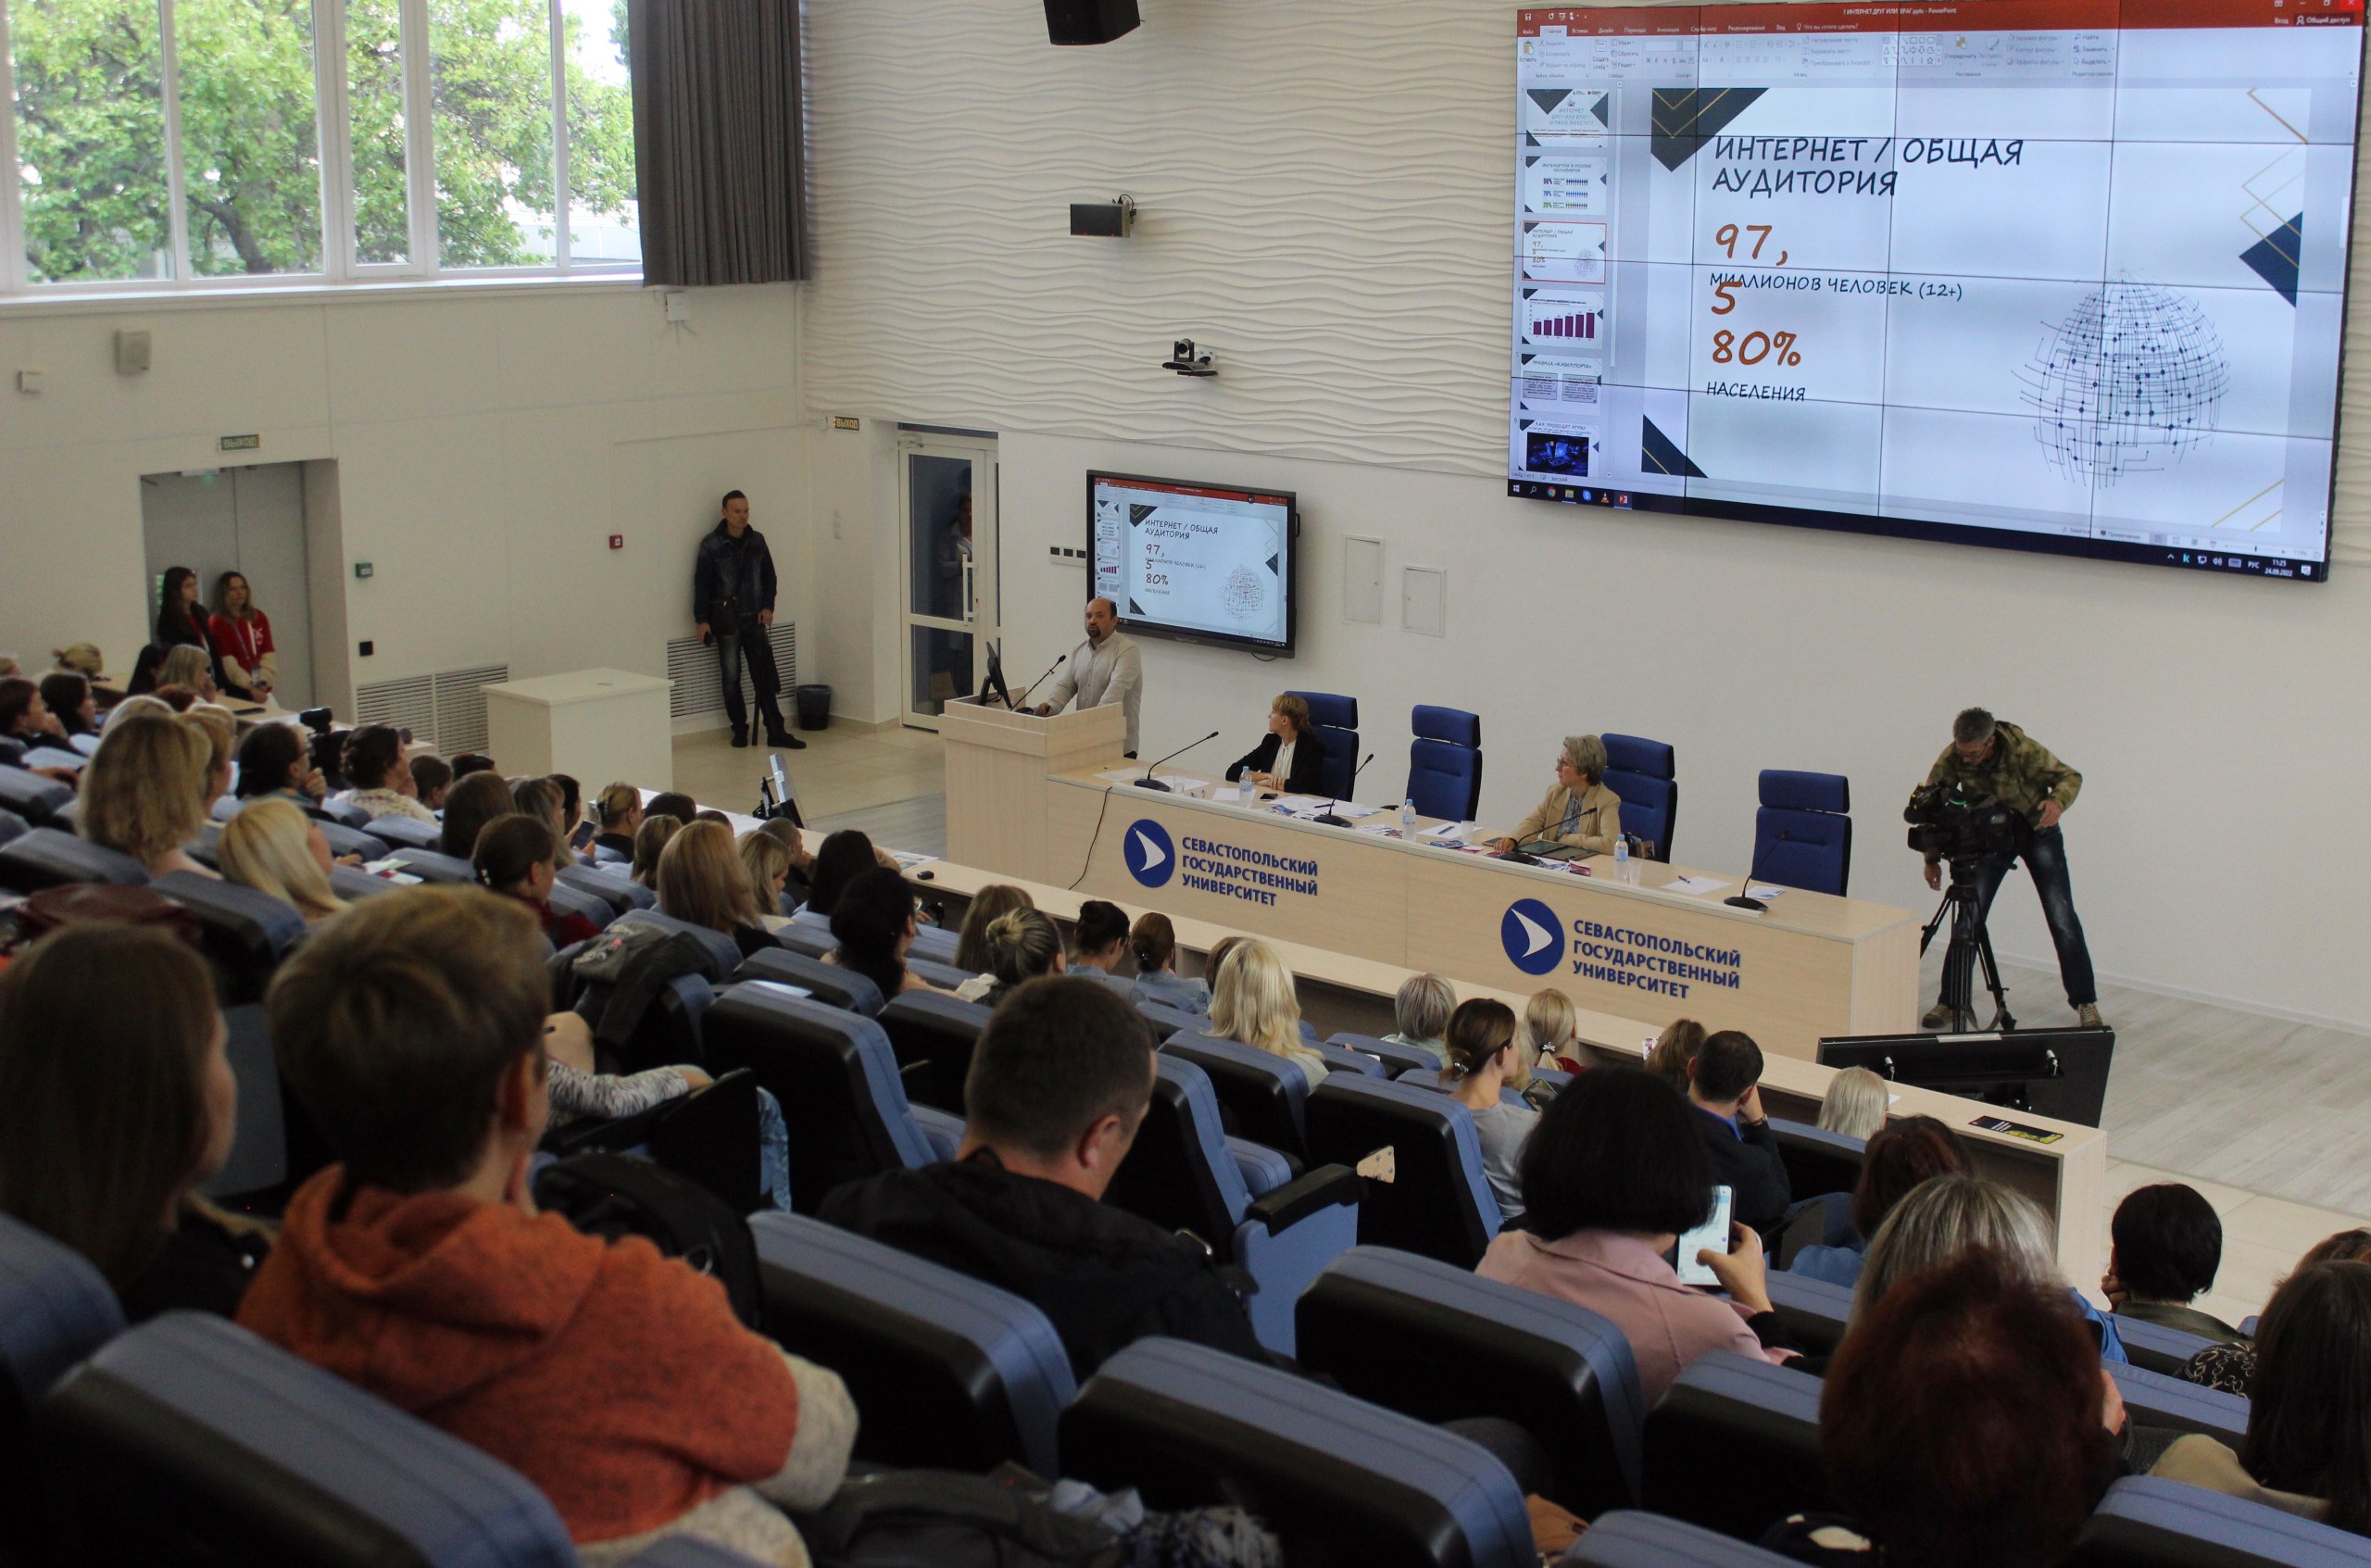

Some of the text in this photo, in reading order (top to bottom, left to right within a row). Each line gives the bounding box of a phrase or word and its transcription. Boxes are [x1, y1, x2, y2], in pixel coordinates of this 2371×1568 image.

[1714, 135, 2024, 169] ИНТЕРНЕТ / ОБЩАЯ
[1712, 167, 1899, 199] АУДИТОРИЯ
[1715, 223, 1788, 267] 97,
[1710, 272, 1963, 302] МИЛЛИОНОВ ЧЕЛОВЕК (12+)
[1711, 280, 1743, 315] 5
[1712, 329, 1801, 366] 80%
[1706, 382, 1806, 402] НАСЕЛЕНИЯ
[835, 418, 859, 429] ВЫХОД
[223, 436, 257, 448] ВЫХОД
[1145, 519, 1182, 530] ИНТЕРНЕТ
[1190, 523, 1219, 534] ОБЩАЯ
[1145, 527, 1190, 540] АУДИТОРИЯ
[1145, 559, 1154, 570] 5
[1146, 544, 1165, 558] 97,
[1146, 572, 1169, 585] 80%
[2264, 568, 2293, 577] 24.09.2022
[1182, 836, 1318, 876] СЕВАСТОПОЛЬСКИЙ
[1182, 855, 1318, 896] ГОСУДАРСТВЕННЫЙ
[1182, 873, 1277, 906] УНИВЕРСИТЕТ
[1574, 920, 1741, 968] СЕВАСТОПОЛЬСКИЙ
[1573, 940, 1740, 989] ГОСУДАРСТВЕННЫЙ
[1573, 960, 1689, 999] УНИВЕРСИТЕТ
